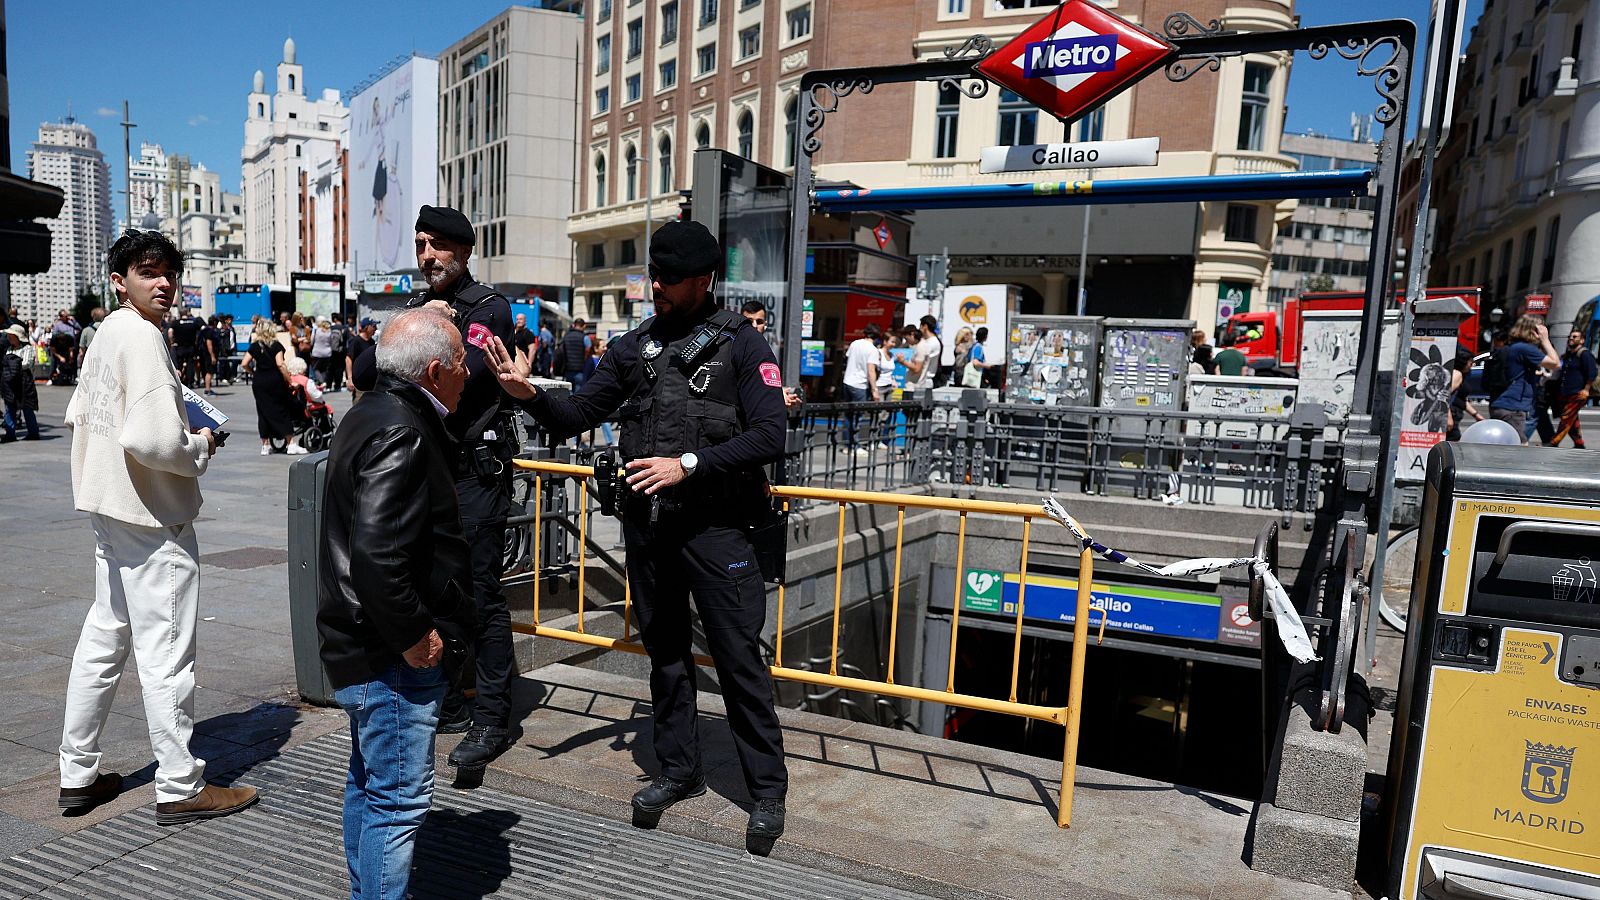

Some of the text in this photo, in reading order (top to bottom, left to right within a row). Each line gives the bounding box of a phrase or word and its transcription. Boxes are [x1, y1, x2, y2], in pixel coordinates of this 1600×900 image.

[1031, 43, 1111, 70] Metro
[1032, 147, 1099, 165] Callao
[1410, 454, 1425, 471] A
[1472, 504, 1516, 514] MADRID
[1060, 613, 1076, 622] Acce
[1106, 619, 1122, 627] Plaza
[1123, 621, 1133, 629] del
[1134, 623, 1154, 632] Callao
[1505, 652, 1537, 660] CENICERO
[1525, 697, 1587, 715] ENVASES
[1507, 709, 1600, 730] PACKAGING WASTE
[1493, 807, 1585, 835] MADRID
